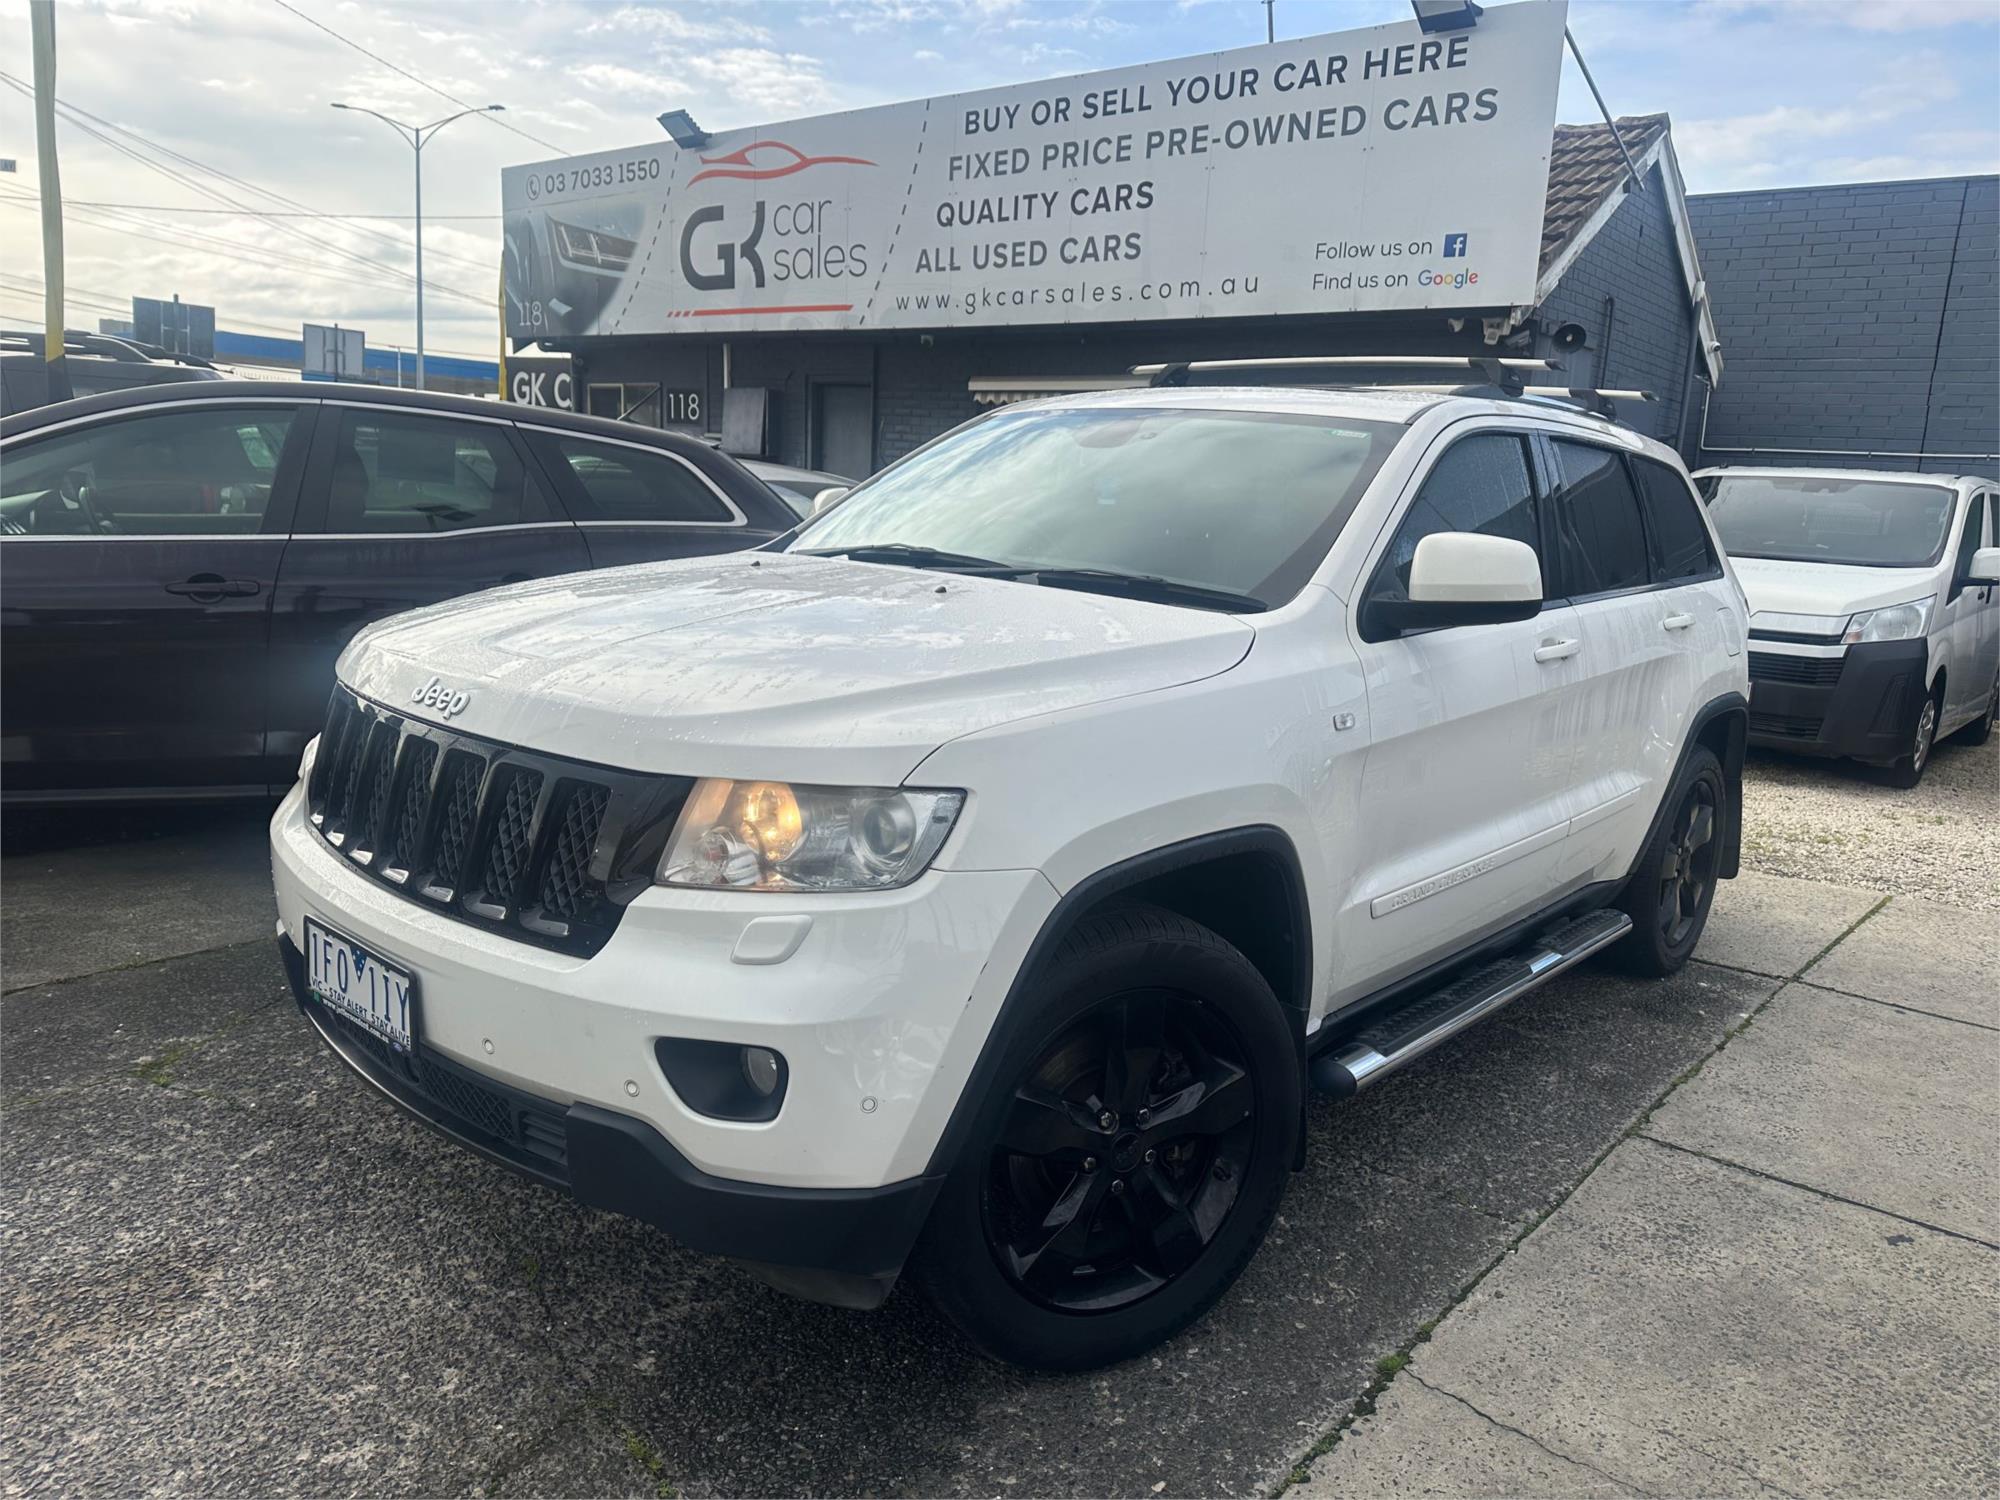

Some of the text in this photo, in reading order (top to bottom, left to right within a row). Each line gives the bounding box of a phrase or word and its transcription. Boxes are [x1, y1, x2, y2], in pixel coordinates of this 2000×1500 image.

[965, 36, 1469, 135] BUY OR SELL YOUR CAR HERE
[949, 88, 1499, 181] FIXED PRICE PRE-OWNED CARS
[545, 158, 660, 194] 03 7033 1550
[773, 200, 832, 236] car
[936, 181, 1154, 227] QUALITY CARS
[680, 200, 765, 291] GK
[773, 234, 867, 281] sales
[915, 232, 1142, 274] ALL USED CARS
[1315, 241, 1376, 260] Follow
[1380, 242, 1402, 257] us
[1408, 241, 1433, 256] on
[896, 276, 1259, 315] www.gkcarsales.com.au
[1312, 268, 1479, 290] Find us on Google
[519, 301, 542, 326] 118
[512, 370, 547, 407] GK
[668, 393, 700, 421] 118
[411, 676, 471, 721] Jeep
[311, 976, 323, 991] VIC
[329, 986, 346, 1002] STAY
[347, 998, 368, 1020] ALERT
[371, 1013, 389, 1032] STAY
[390, 1029, 411, 1048] ALIVE
